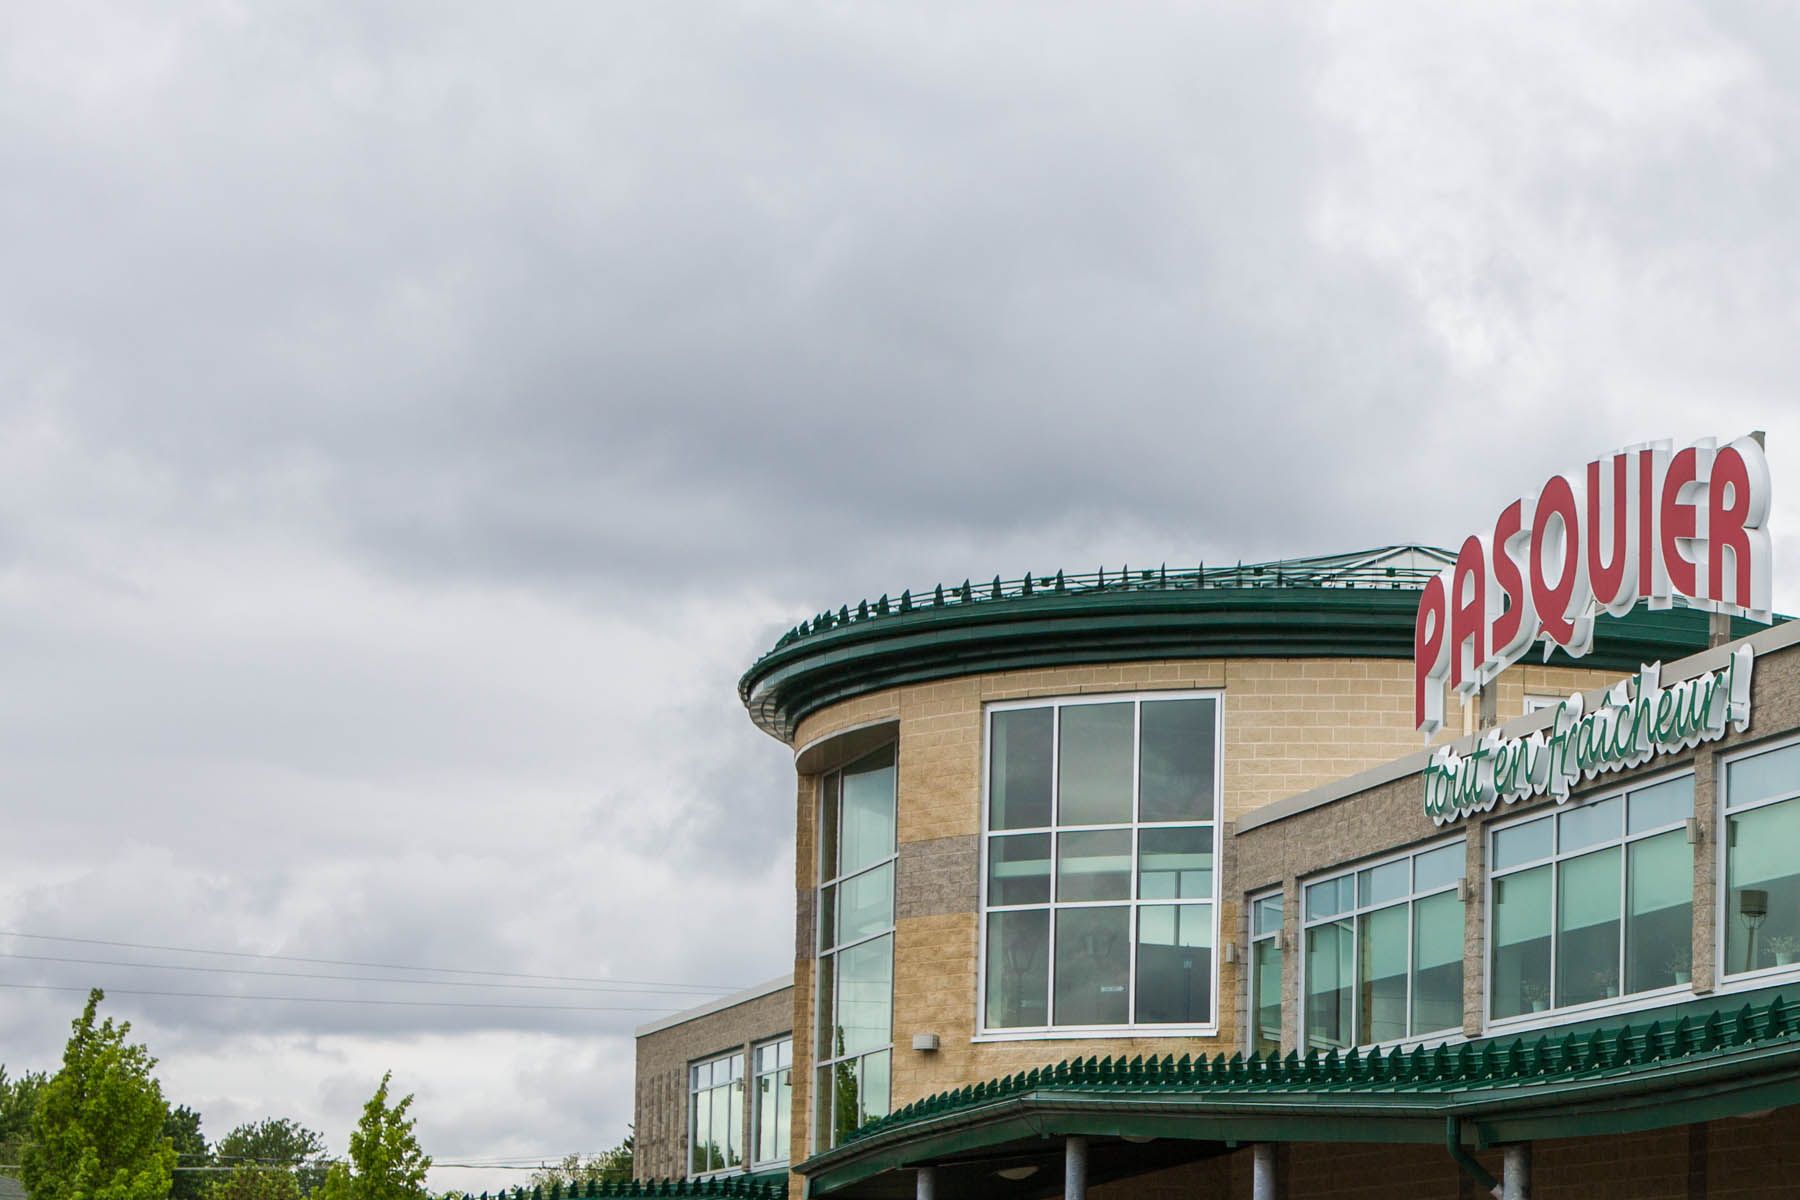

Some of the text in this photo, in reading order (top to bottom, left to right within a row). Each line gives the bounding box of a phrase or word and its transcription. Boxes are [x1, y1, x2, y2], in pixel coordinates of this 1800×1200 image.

[1415, 446, 1752, 732] PASQUIER
[1422, 652, 1736, 818] tout en fraîcheur!
